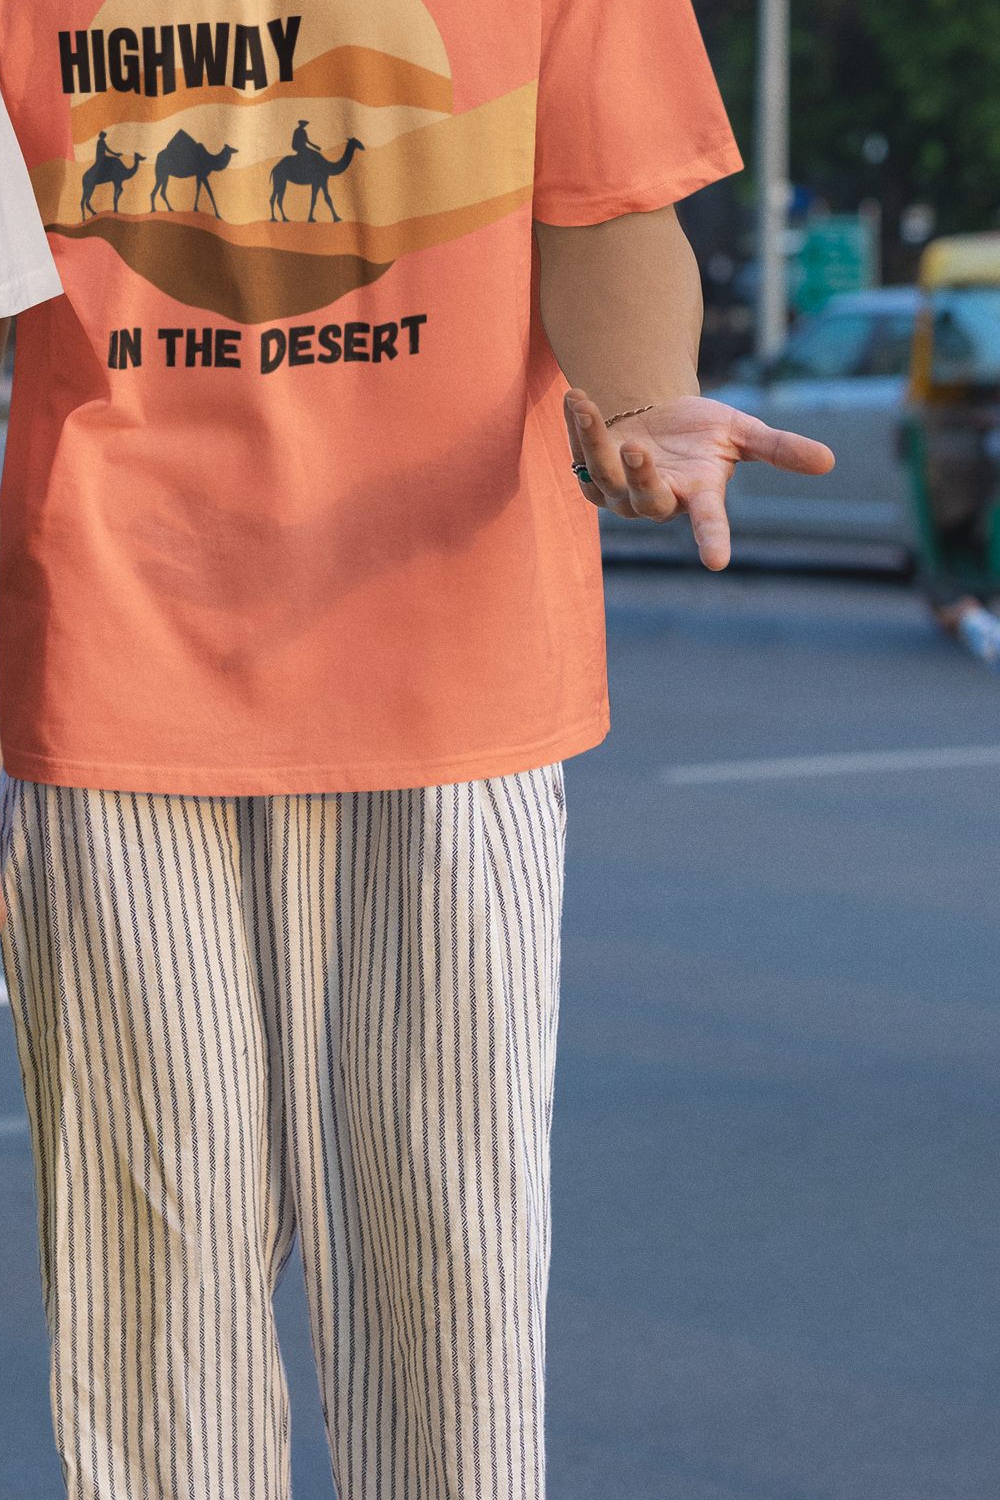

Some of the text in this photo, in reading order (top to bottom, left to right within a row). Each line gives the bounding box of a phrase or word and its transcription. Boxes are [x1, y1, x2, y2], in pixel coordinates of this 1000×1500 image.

[58, 16, 302, 97] HIGHWAY
[108, 314, 427, 374] IN THE DESERT
